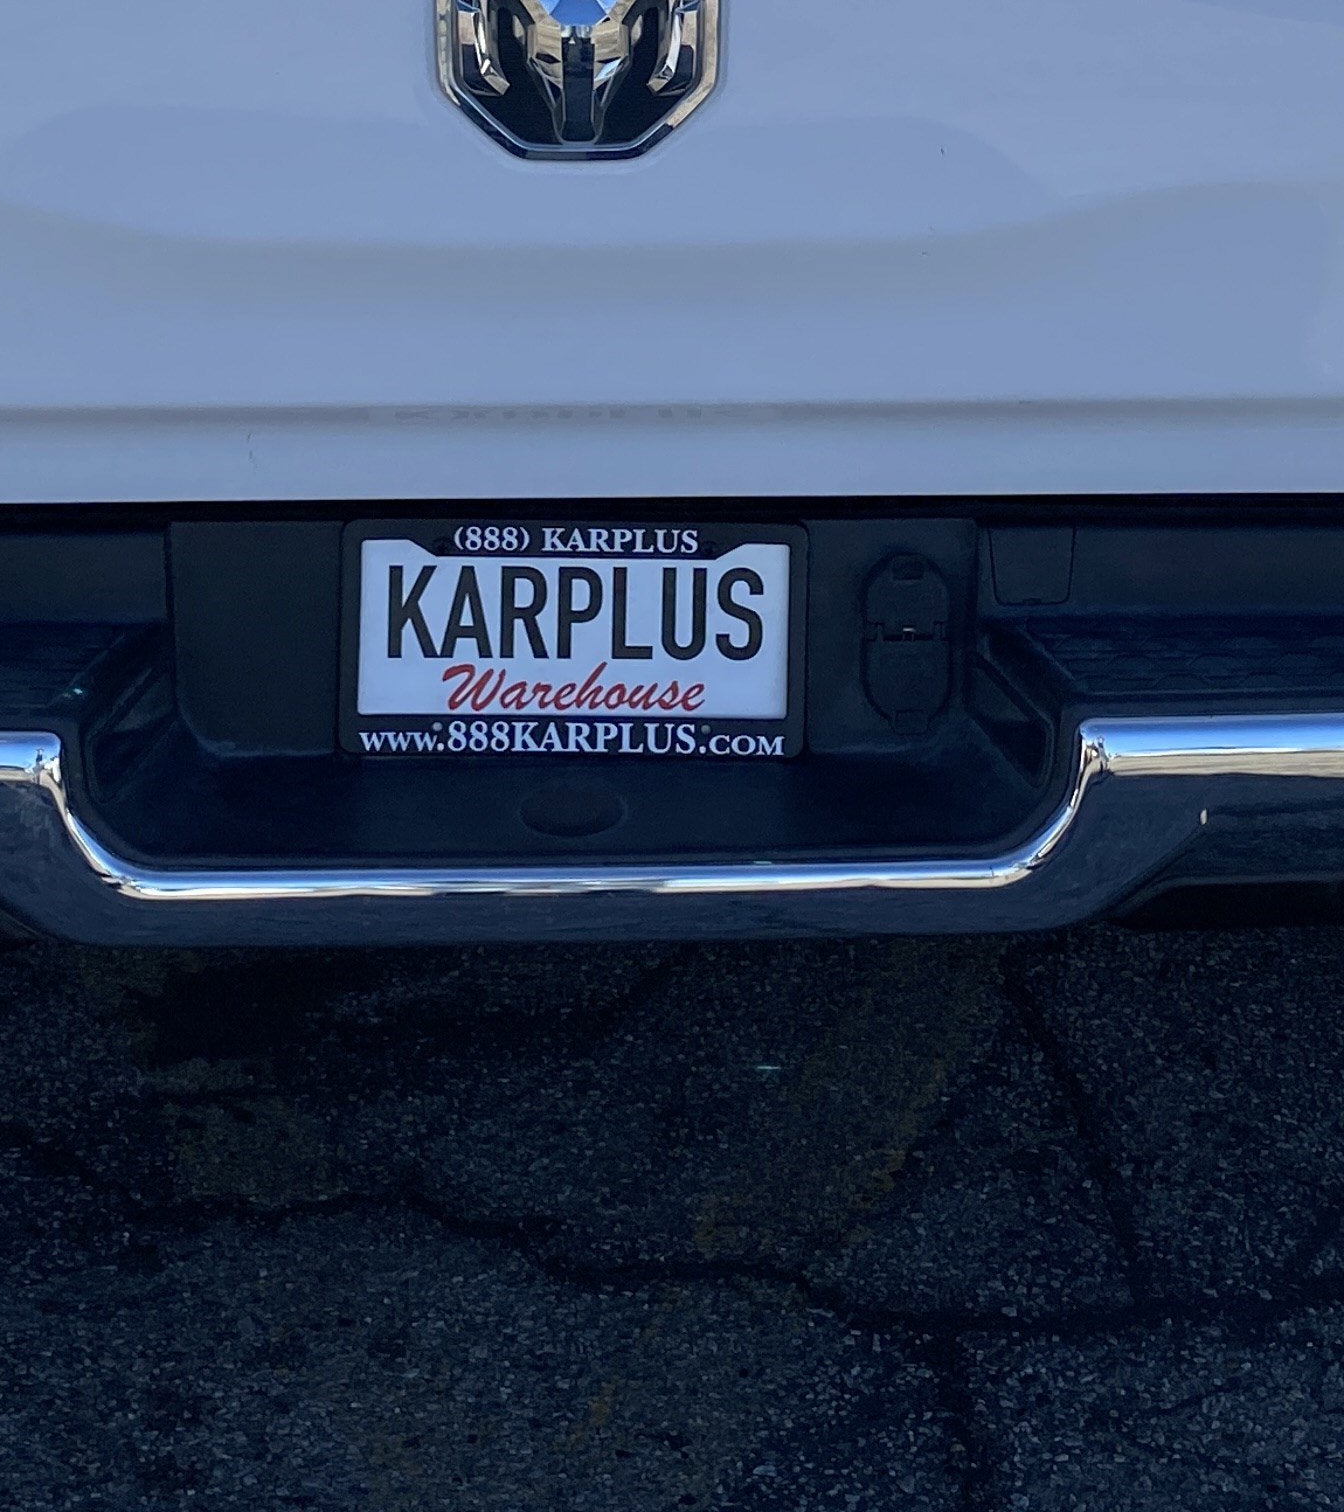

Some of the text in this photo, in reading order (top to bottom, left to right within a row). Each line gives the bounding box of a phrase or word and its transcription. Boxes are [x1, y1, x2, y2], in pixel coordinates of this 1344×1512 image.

[453, 525, 699, 555] (888) KARPLUS
[386, 564, 765, 662] KARPLUS
[442, 661, 706, 712] Warehouse
